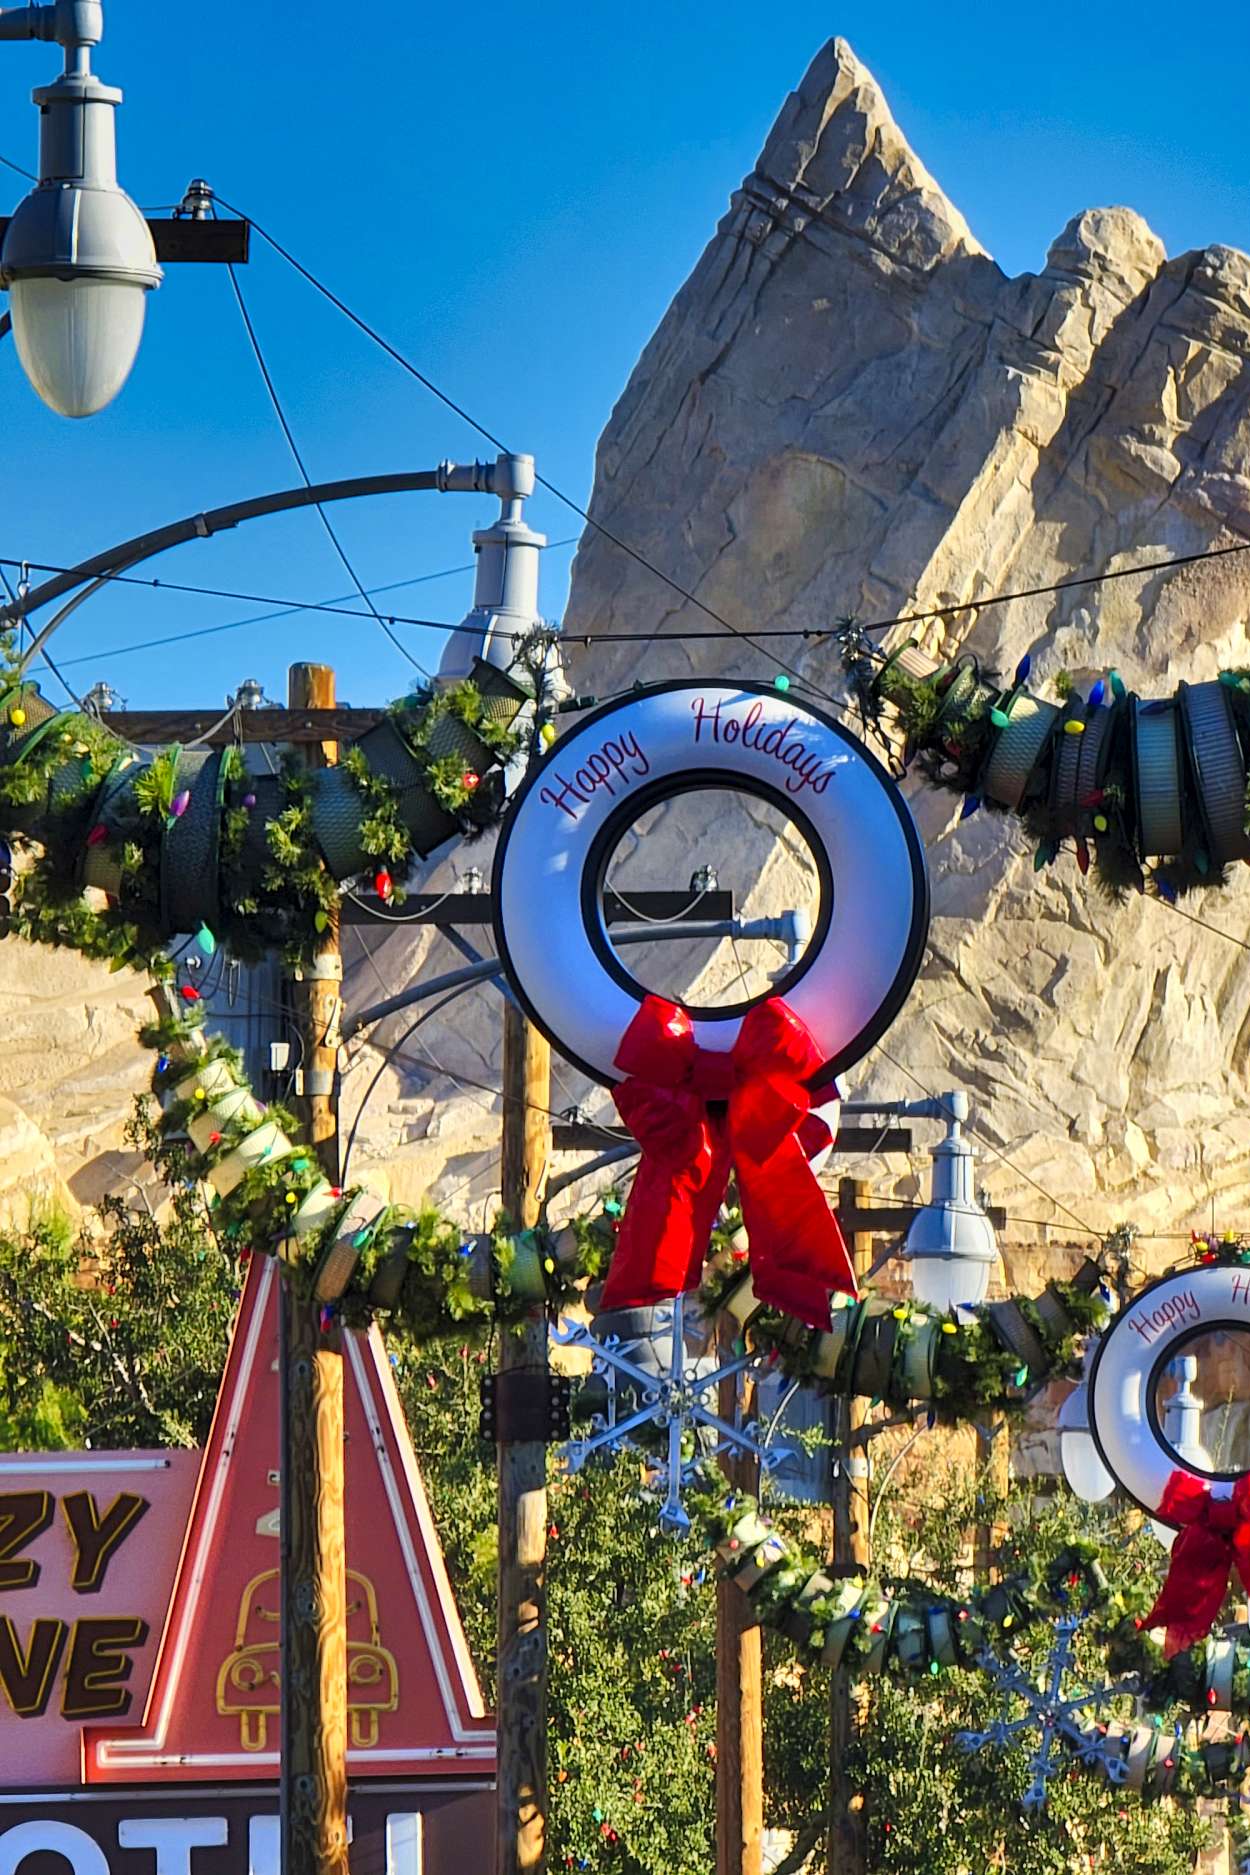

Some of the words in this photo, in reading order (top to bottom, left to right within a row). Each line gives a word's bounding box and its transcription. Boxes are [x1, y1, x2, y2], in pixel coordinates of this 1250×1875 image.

[540, 729, 650, 820] Happy
[691, 696, 837, 795] Holidays
[1128, 1289, 1201, 1344] Happy
